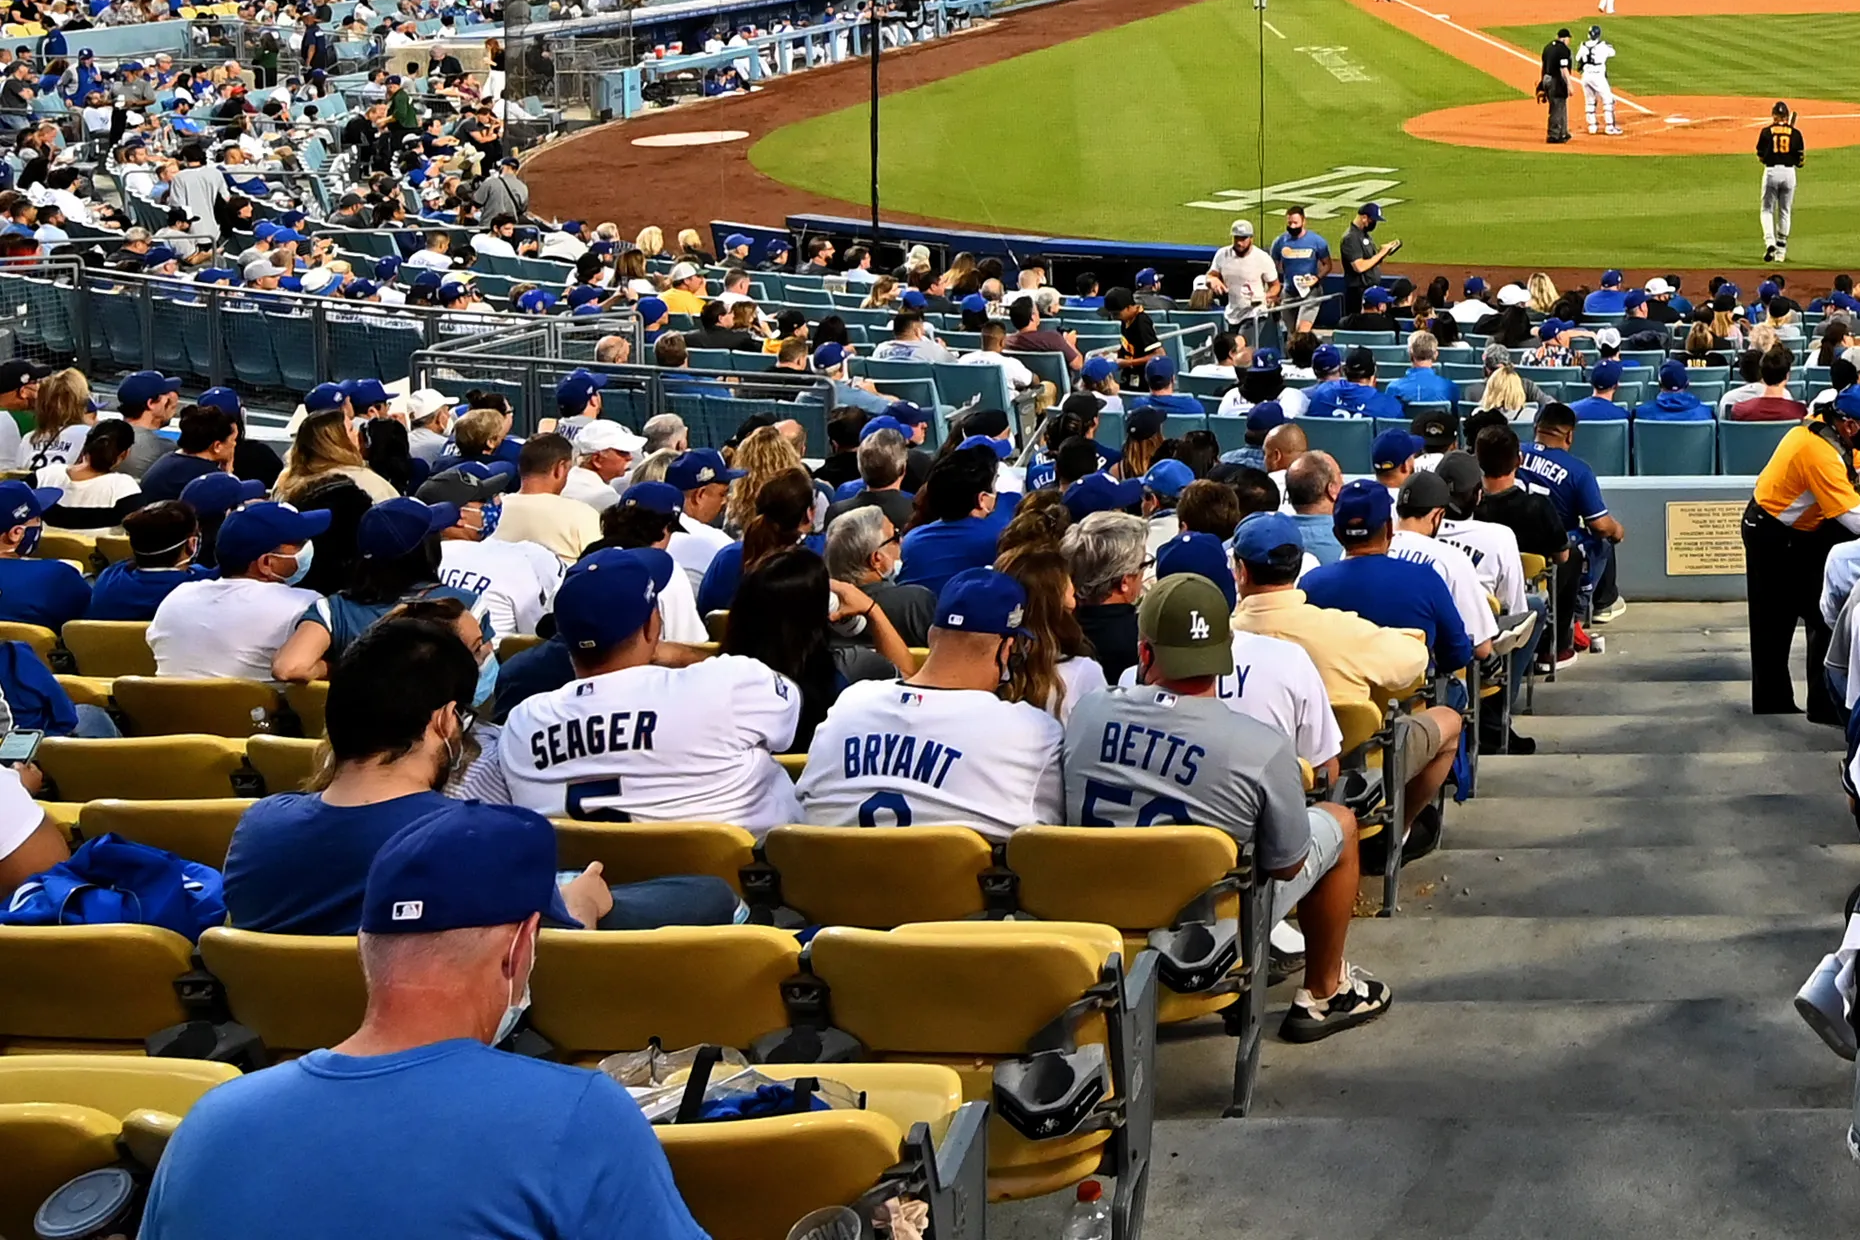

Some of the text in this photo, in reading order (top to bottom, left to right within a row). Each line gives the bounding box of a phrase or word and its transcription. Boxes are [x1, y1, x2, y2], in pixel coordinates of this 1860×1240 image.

[1772, 135, 1791, 154] 19
[1190, 610, 1210, 640] LA
[531, 711, 658, 770] SEAGER
[844, 733, 962, 789] BRYANT
[1100, 722, 1205, 786] BETTS
